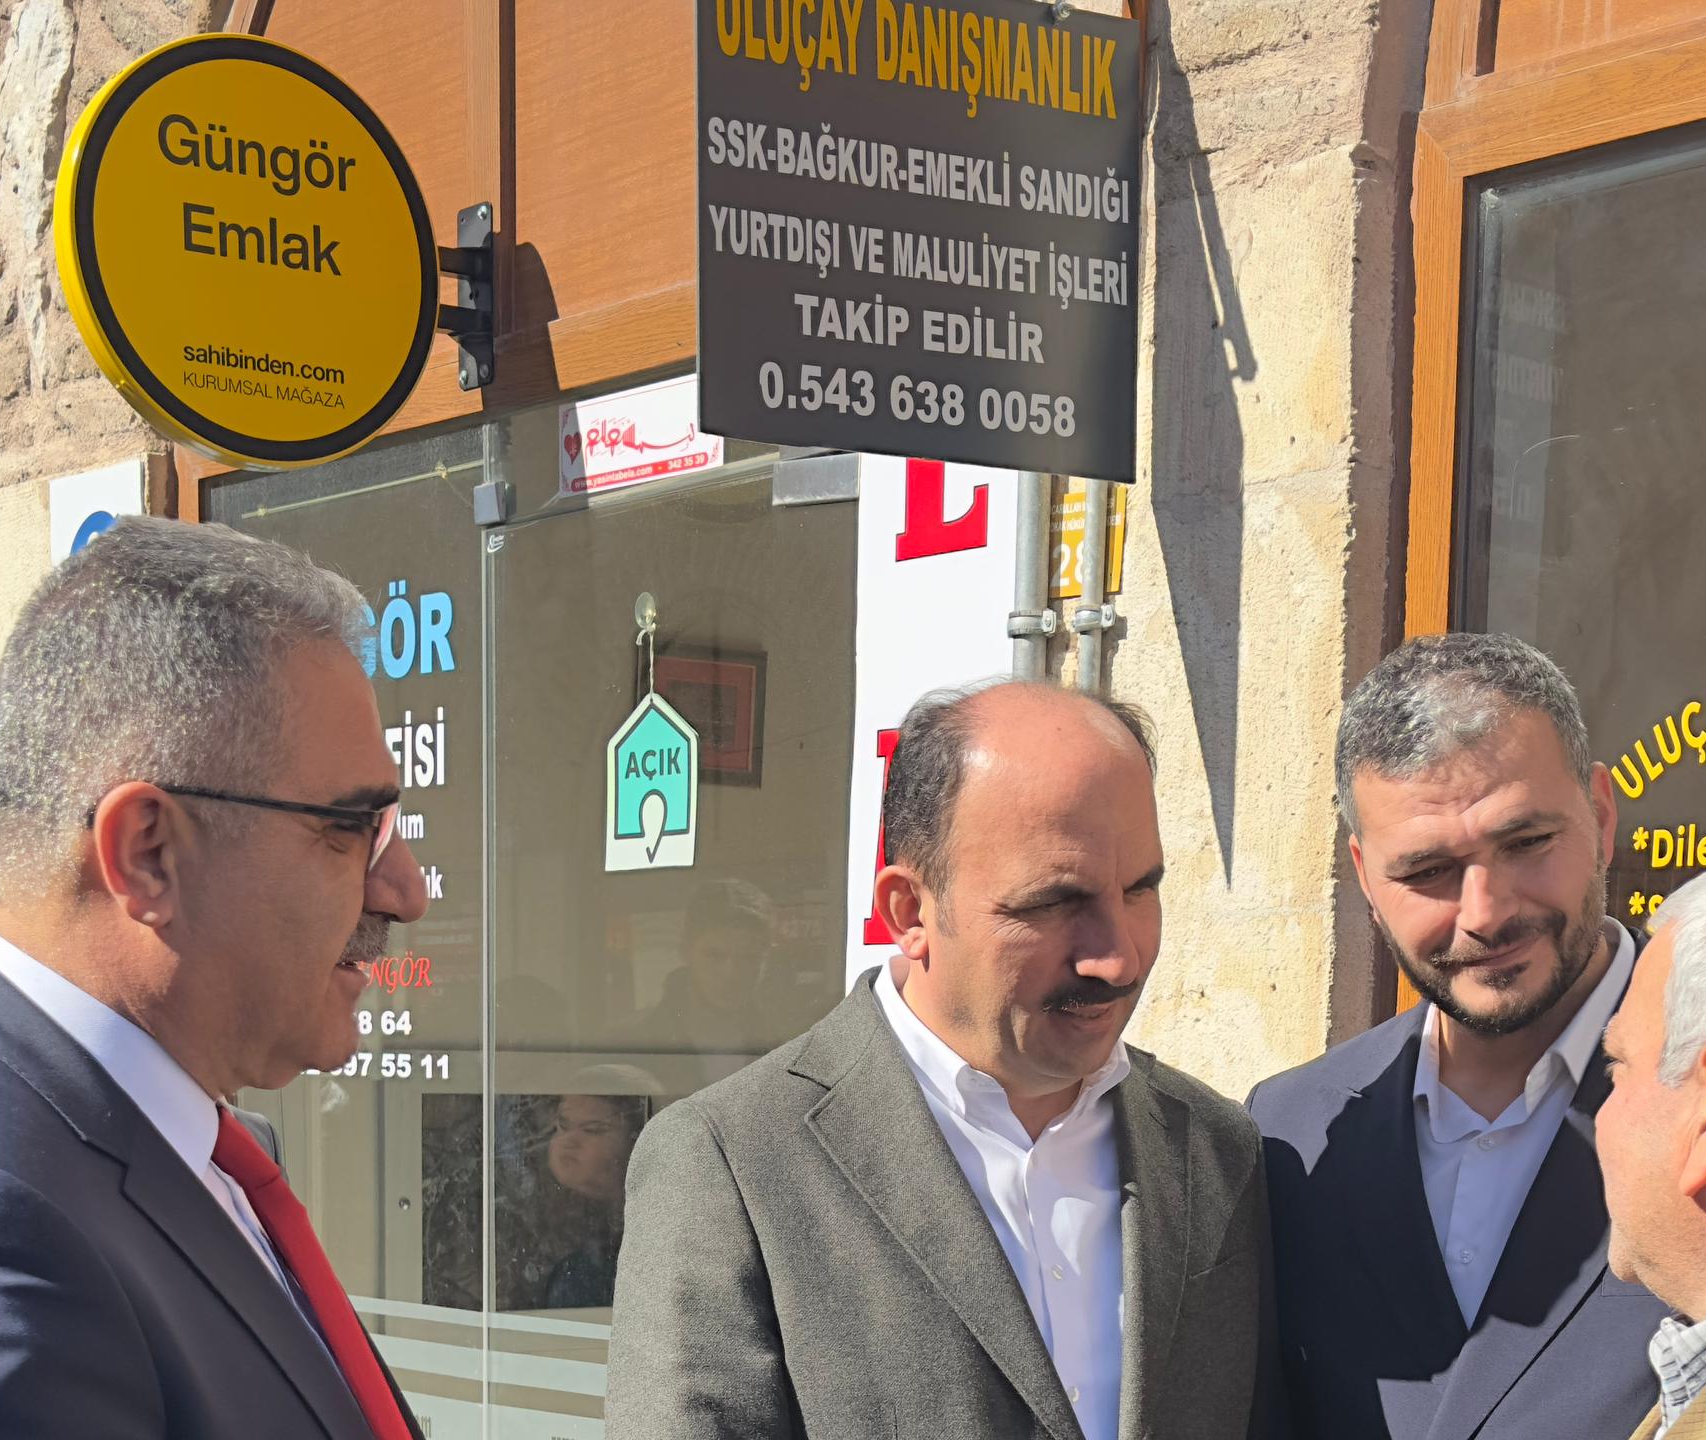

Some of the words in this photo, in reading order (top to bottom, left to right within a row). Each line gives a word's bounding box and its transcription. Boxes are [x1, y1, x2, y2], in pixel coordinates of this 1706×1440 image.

[715, 0, 864, 92] ULUÇAY
[876, 0, 1117, 119] DANIŞMANLIK
[157, 113, 356, 196] Güngör
[708, 117, 1010, 207] SSK-BAĞKUR-EMEKLİ
[1020, 165, 1129, 223] SANDIĞI
[182, 202, 342, 276] Emlak
[709, 205, 840, 278] YURTDIŞI
[849, 224, 884, 274] VE
[893, 231, 1041, 294] MALULİYET
[1049, 241, 1128, 309] İŞLERİ
[795, 293, 909, 346] TAKİP
[923, 306, 1044, 363] EDİLİR
[183, 344, 345, 384] sahibinden.com
[183, 370, 272, 399] KURUMSAL
[277, 384, 345, 409] MAĞAZA
[759, 361, 875, 416] 0.543
[890, 374, 964, 426] 638
[979, 388, 1075, 437] 0058
[625, 746, 681, 781] AÇIK
[359, 951, 433, 994] NGÖR
[381, 1010, 412, 1036] 64
[381, 1053, 412, 1078] 55
[420, 1054, 449, 1079] 11
